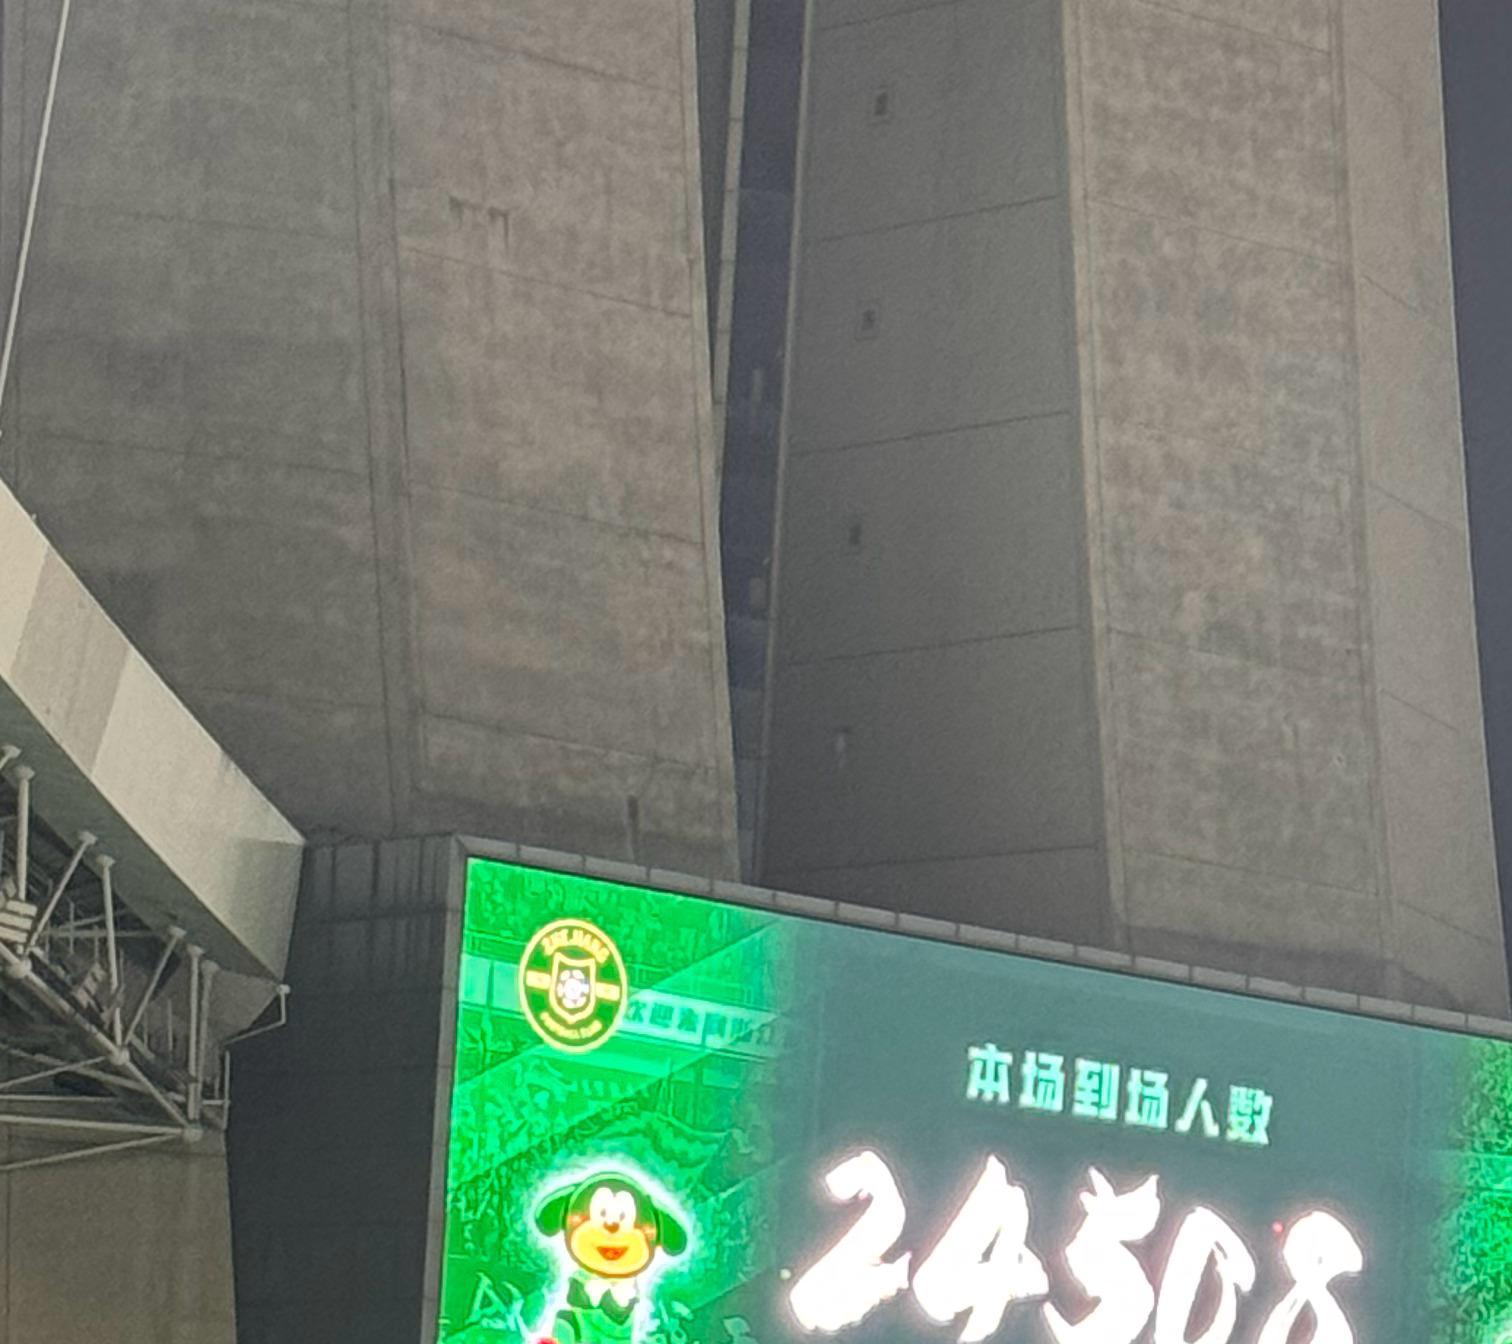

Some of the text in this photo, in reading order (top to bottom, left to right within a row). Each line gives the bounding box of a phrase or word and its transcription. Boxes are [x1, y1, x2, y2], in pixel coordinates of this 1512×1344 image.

[966, 1043, 1273, 1145] 本场到场人数
